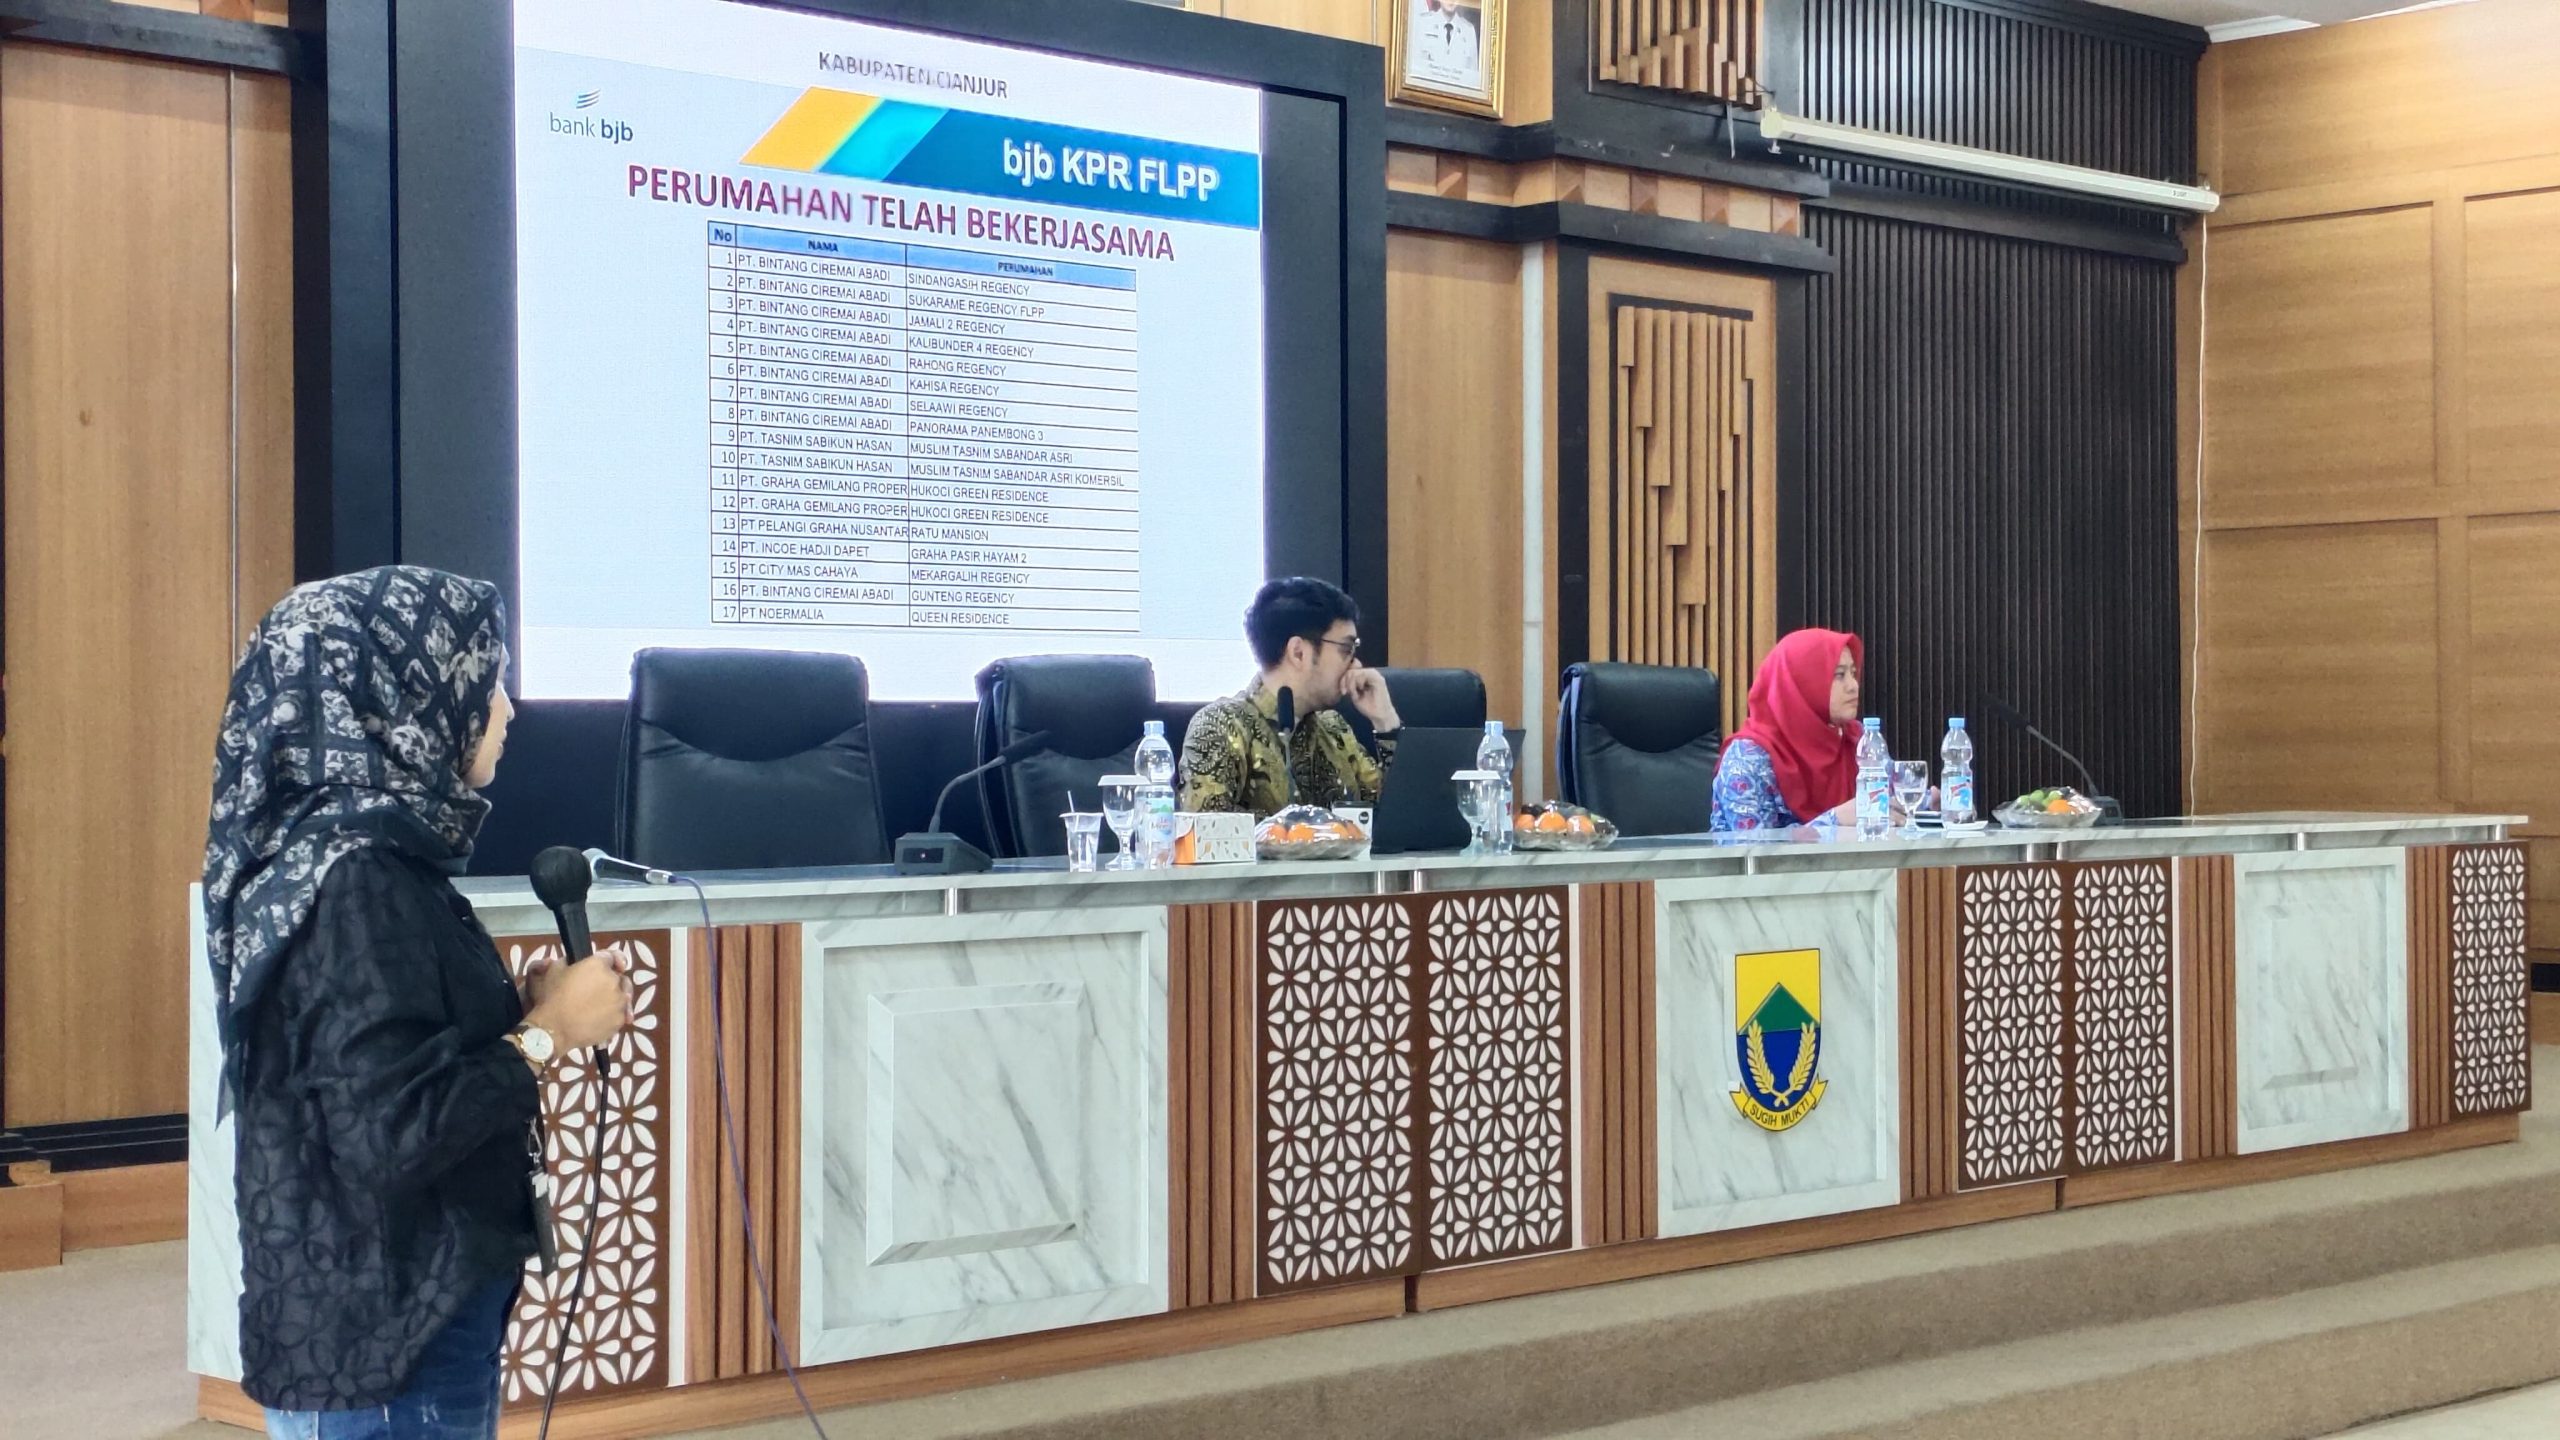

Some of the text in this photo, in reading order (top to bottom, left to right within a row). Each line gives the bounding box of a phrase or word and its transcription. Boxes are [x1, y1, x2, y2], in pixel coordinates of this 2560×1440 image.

[819, 51, 930, 86] KABUPATEN
[550, 111, 634, 145] bank bjb
[1003, 138, 1220, 202] bjb KPR FLPP
[629, 164, 1175, 262] PERUMAHAN TELAH BEKERJASAMA
[714, 228, 733, 242] No
[808, 240, 839, 252] NAMA
[727, 252, 733, 264] 1
[738, 253, 890, 281] PT. BINTANG CIREMAI ABADI
[997, 262, 1053, 277] PERUMAHAN
[726, 274, 733, 287] 2
[908, 272, 1029, 296] SINDANGASIH REGENCY
[738, 276, 890, 303] PT. BINTANG CIREMAI ABADI
[726, 296, 733, 309] 3
[908, 293, 1044, 318] SUKARAME REGENCY FLPP
[738, 298, 890, 324] PT. BINTANG CIREMAI ABADI
[726, 318, 734, 330] 4
[738, 319, 890, 345] PT. BINTANG CIREMAI ABADI
[908, 314, 1005, 335] JAMALI 2 REGENCY
[727, 340, 734, 353] 5
[739, 342, 891, 367] PT. BINTANG CIREMAI ABADI
[909, 335, 1034, 358] KALIBUNDER 4 REGENCY
[727, 362, 734, 375] 6
[909, 357, 1006, 377] RAHONG REGENCY
[739, 363, 891, 388] PT. BINTANG CIREMAI ABADI
[728, 384, 734, 397] 7
[909, 378, 999, 396] KAHISA REGENCY
[739, 386, 891, 409] PT. BINTANG CIREMAI ABADI
[728, 406, 734, 419] 8
[958, 403, 1008, 418] REGENCY
[739, 408, 891, 430] PT. BINTANG CIREMAI ABADI
[727, 429, 735, 441] 9
[910, 421, 1043, 441] PANORAMA PANEMBONG 3
[739, 430, 892, 452] PT. TASNIM SABIKUN HASAN
[721, 450, 735, 463] 10
[910, 442, 1072, 463] MUSLIM TASNIM SABANDAR ASRI
[740, 452, 892, 473] PT. TASNIM SABIKUN HASAN
[722, 472, 735, 485] 11
[910, 463, 1124, 486] MUSLIM TASNIM SABANDAR ASRI KOMERSIL
[740, 474, 758, 487] PT.
[761, 475, 800, 489] GRAHA
[803, 478, 860, 492] GEMILANG
[722, 495, 735, 508] 12
[910, 484, 1048, 503] HUKOCI GREEN RESIDENCE
[740, 496, 758, 509] PT.
[761, 497, 800, 511] GRAHA
[803, 500, 860, 514] GEMILANG
[910, 505, 1048, 523] HUKOCI GREEN RESIDENCE
[722, 517, 735, 529] 13
[758, 519, 806, 533] PELANGI
[809, 521, 848, 534] GRAHA
[911, 526, 988, 541] RATU MANSION
[722, 539, 736, 552] 14
[741, 540, 869, 557] PT. INCOE HADJI DAPET
[911, 548, 1026, 563] GRAHA PASIR HAYAM 2
[723, 561, 736, 574] 15
[758, 563, 784, 575] CITY
[787, 564, 810, 576] MAS
[813, 565, 858, 578] CAHAYA
[911, 569, 1030, 584] MEKARGALIH REGENCY
[723, 583, 736, 595] 16
[741, 584, 893, 600] PT. BINTANG CIREMAI ABADI
[911, 589, 1014, 604] GUNTENG REGENCY
[723, 605, 736, 618] 17
[759, 607, 824, 620] NOERMALIA
[911, 611, 1009, 624] QUEEN RESIDENCE
[1749, 1097, 1810, 1126] SUGIH MUKTI
